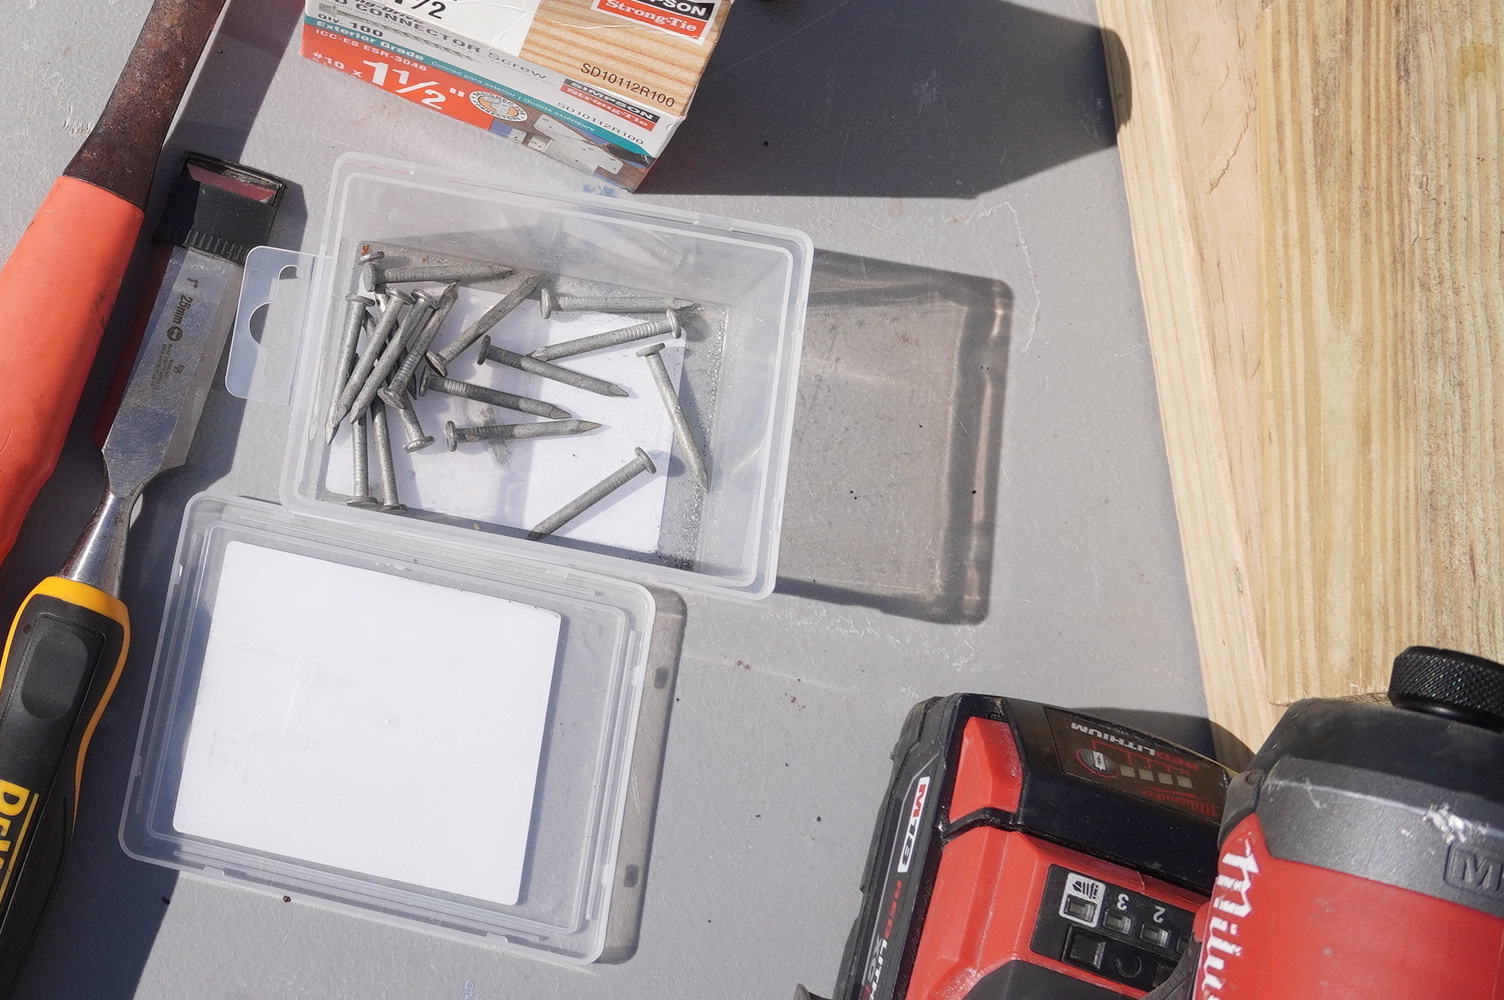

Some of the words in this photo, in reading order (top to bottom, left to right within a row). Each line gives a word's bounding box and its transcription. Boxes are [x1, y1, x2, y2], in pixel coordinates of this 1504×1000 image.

[316, 29, 359, 47] ICC-ES
[364, 44, 426, 72] ESR-3046
[351, 23, 383, 37] 100
[356, 4, 480, 53] CONNECTOR
[489, 51, 546, 79] Screw
[313, 51, 344, 70] #10
[353, 69, 362, 78] x
[317, 21, 376, 44] Exterior
[380, 42, 424, 61] Grade
[431, 61, 462, 76] Calidad
[464, 74, 482, 84] para
[484, 80, 516, 98] exterior
[523, 95, 553, 112] Qualité
[581, 63, 675, 108] SD10112R100
[570, 80, 654, 120] SIMPSON
[556, 102, 644, 145] SD10112R100
[170, 293, 195, 326] 25mm
[902, 784, 926, 867] M18
[1116, 893, 1129, 910] 3
[1152, 906, 1166, 924] 2
